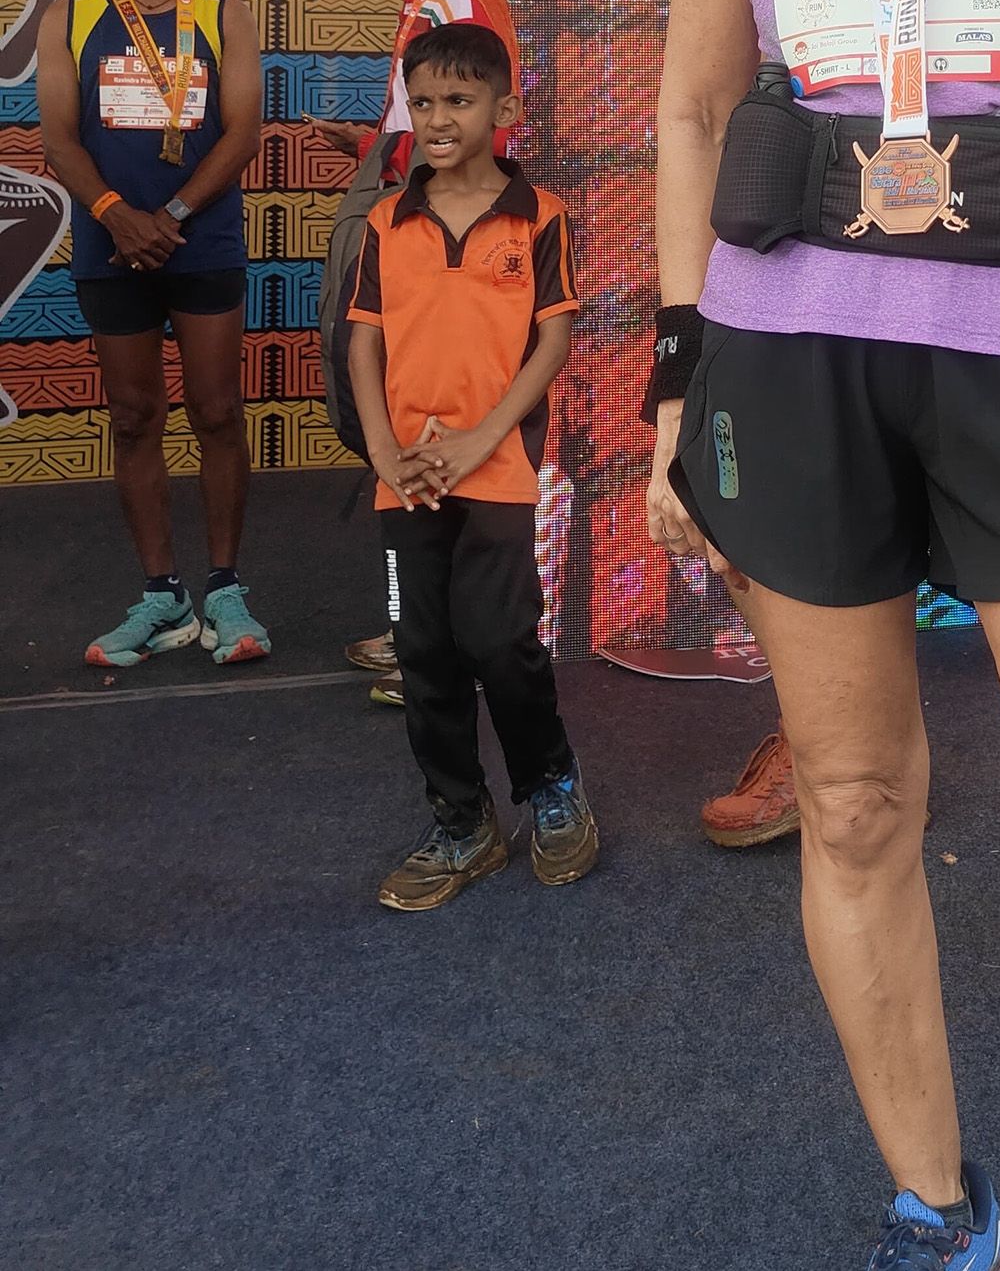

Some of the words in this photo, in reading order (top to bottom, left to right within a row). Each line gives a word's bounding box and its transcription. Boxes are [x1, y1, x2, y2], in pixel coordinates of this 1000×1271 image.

[809, 3, 823, 12] RUN
[898, 0, 918, 45] RUN
[957, 33, 992, 42] MALA'S
[816, 64, 839, 77] T-SHIRT
[846, 63, 851, 71] L
[178, 71, 187, 89] RUN
